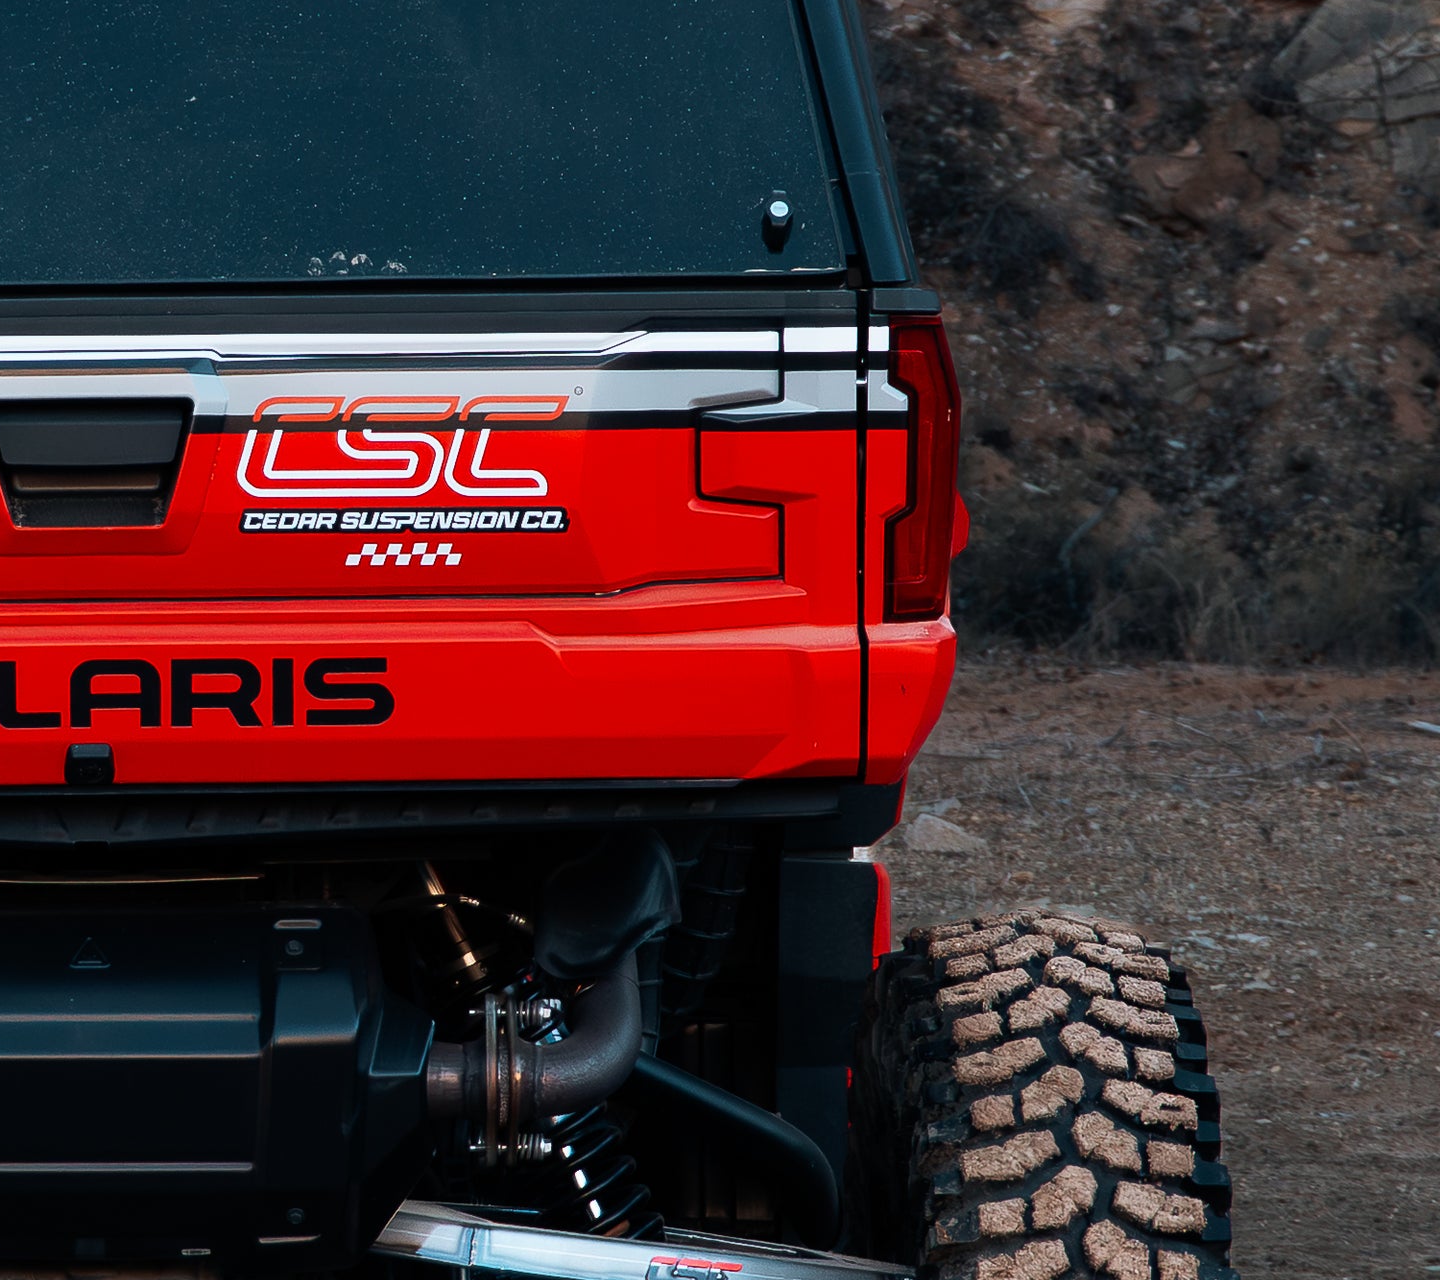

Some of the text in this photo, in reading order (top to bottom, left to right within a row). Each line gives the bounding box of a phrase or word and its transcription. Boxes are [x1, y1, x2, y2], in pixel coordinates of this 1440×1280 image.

[243, 511, 565, 530] CEDAR SUSPENSION CO.
